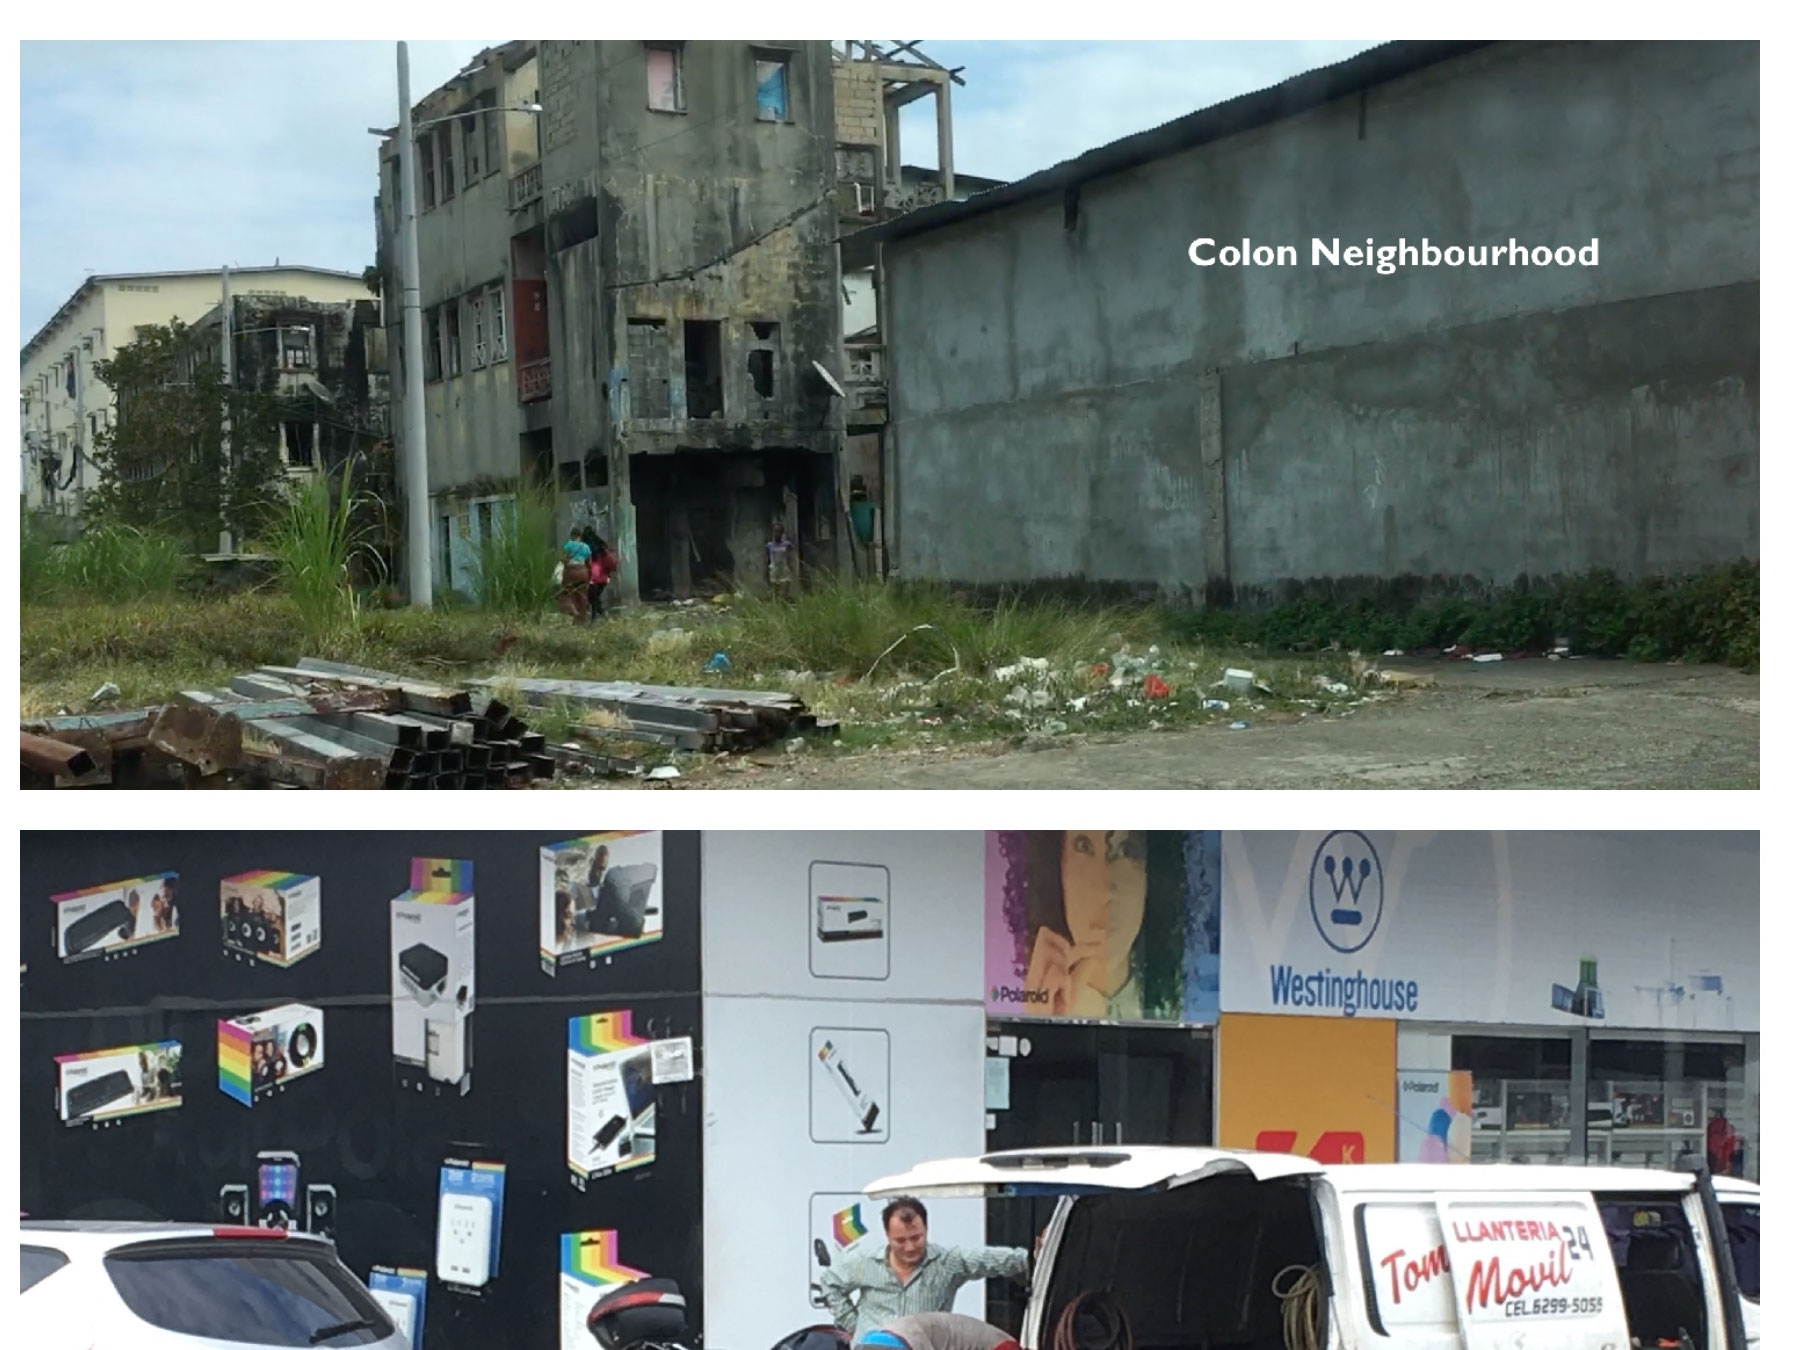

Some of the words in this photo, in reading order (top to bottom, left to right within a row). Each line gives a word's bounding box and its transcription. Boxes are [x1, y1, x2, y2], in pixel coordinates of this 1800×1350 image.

[999, 985, 1050, 1004] Polaroid
[1269, 963, 1419, 1018] Westinghouse
[1452, 1219, 1563, 1243] LLANTERIA
[1561, 1225, 1594, 1261] 24
[1465, 1240, 1573, 1315] Movil
